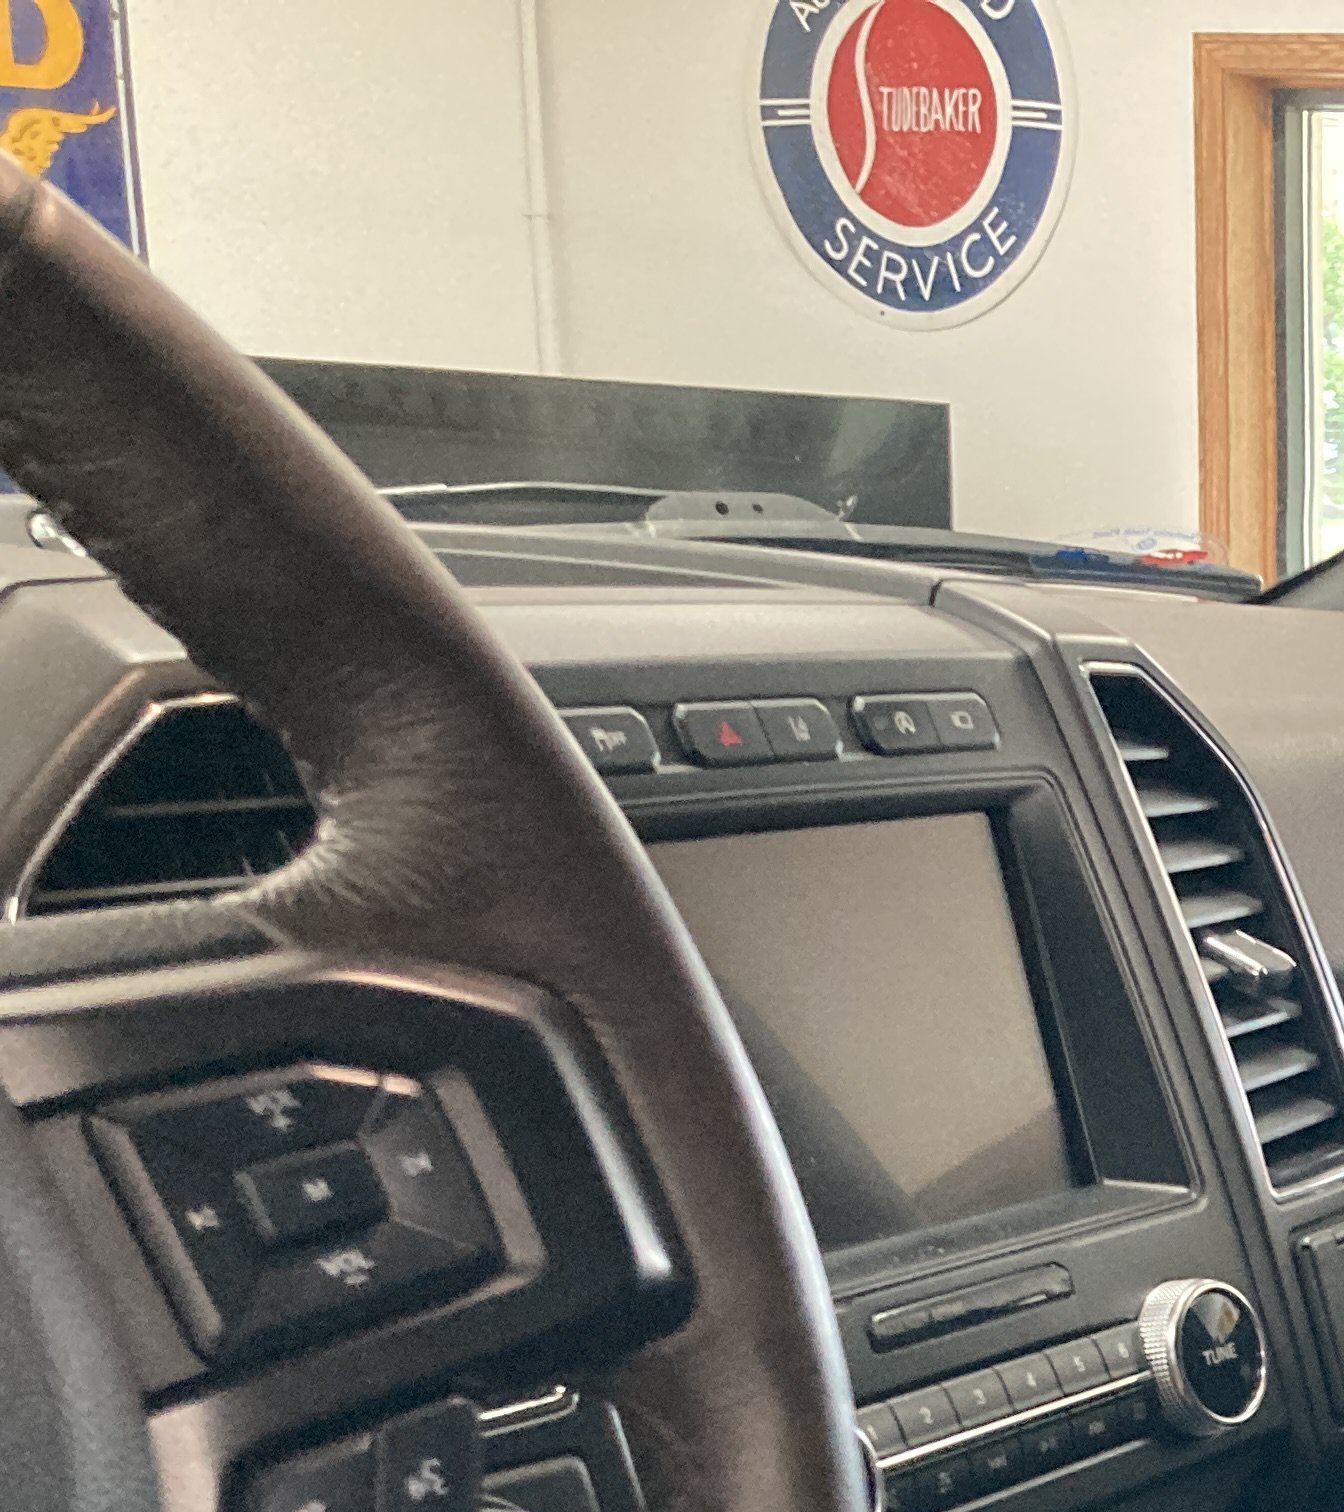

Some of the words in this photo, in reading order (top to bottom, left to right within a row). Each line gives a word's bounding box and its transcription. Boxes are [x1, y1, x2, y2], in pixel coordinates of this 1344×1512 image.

[824, 206, 1017, 302] SERVICE
[1202, 1342, 1238, 1366] TUNE
[920, 1406, 934, 1425] 2
[973, 1388, 988, 1405] 3
[1026, 1372, 1037, 1388] 4
[1073, 1355, 1086, 1372] 5
